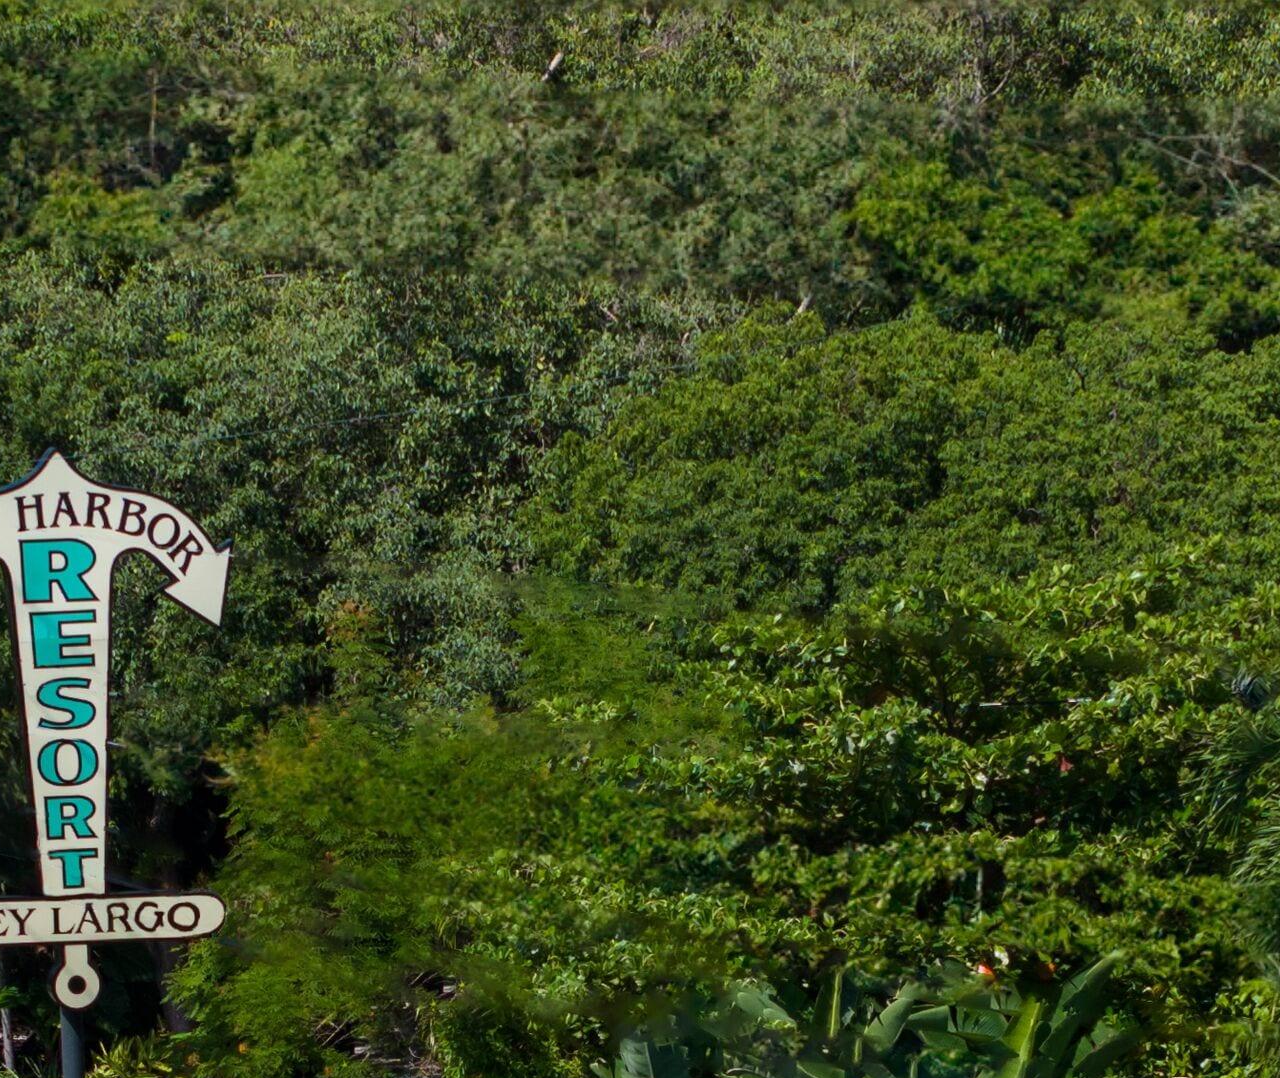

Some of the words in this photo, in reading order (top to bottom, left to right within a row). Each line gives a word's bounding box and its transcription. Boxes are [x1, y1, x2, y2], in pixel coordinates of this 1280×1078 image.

[16, 491, 204, 576] HARBOR
[18, 538, 100, 889] RESORT
[53, 901, 201, 936] LARGO
